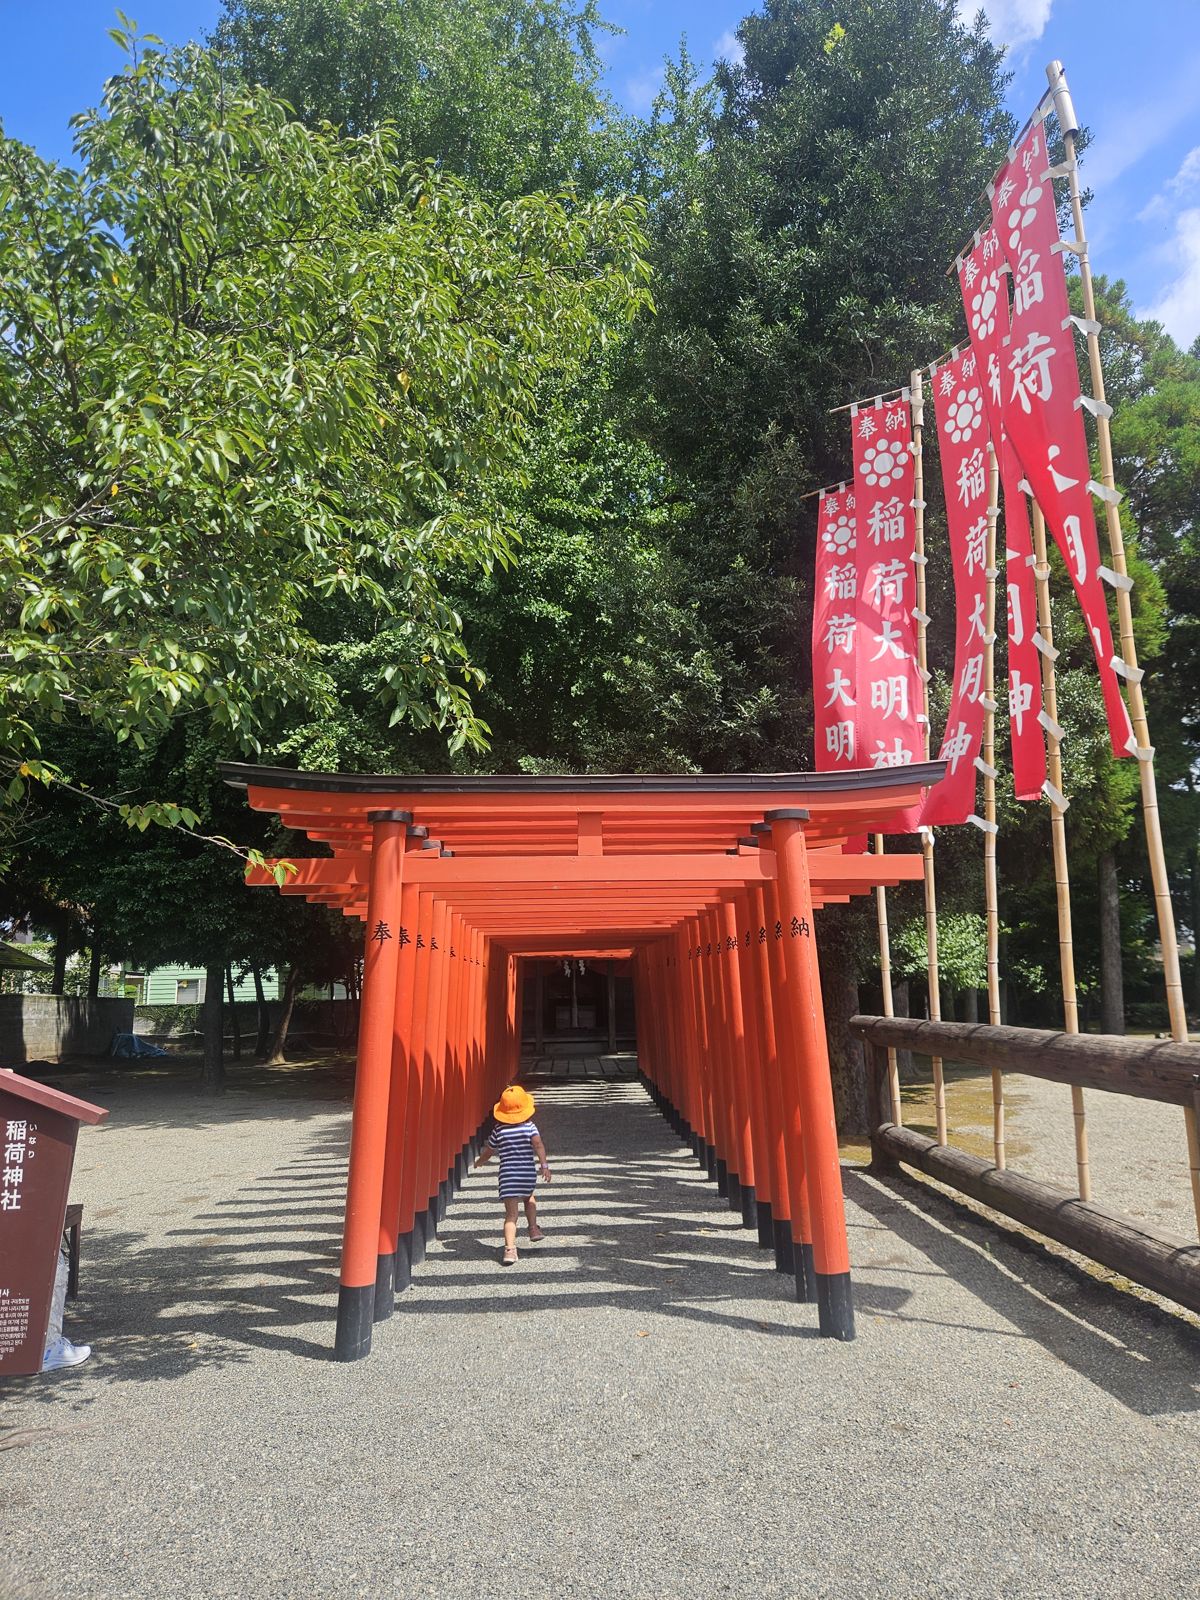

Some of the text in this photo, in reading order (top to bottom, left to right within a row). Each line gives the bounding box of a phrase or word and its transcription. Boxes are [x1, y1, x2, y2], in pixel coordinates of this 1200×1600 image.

[857, 408, 907, 440] 奉納
[371, 920, 392, 945] 奉
[790, 916, 810, 938] 納
[28, 1124, 37, 1158] いなり
[1, 1120, 26, 1211] 稲荷神社
